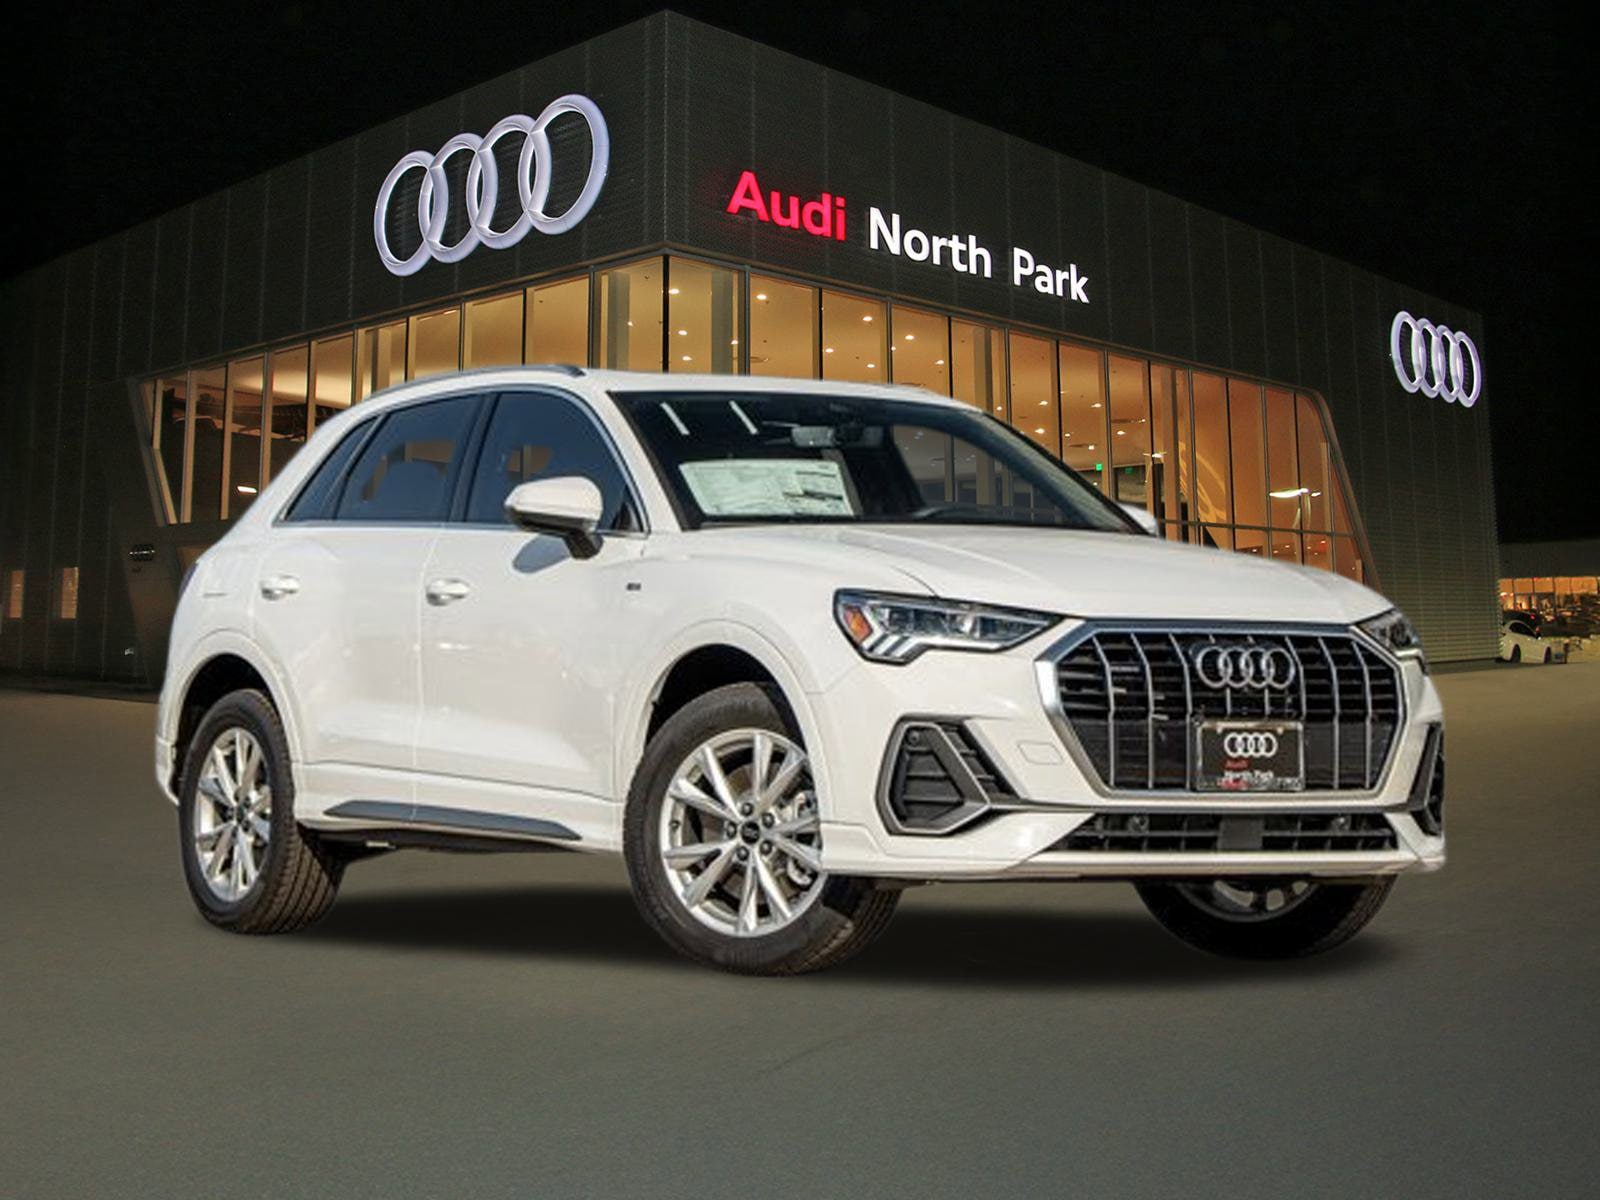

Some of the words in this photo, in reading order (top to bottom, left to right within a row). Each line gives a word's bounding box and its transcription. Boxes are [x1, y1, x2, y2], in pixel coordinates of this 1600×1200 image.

[727, 170, 847, 241] Audi
[869, 207, 993, 279] North
[1013, 246, 1091, 304] Park
